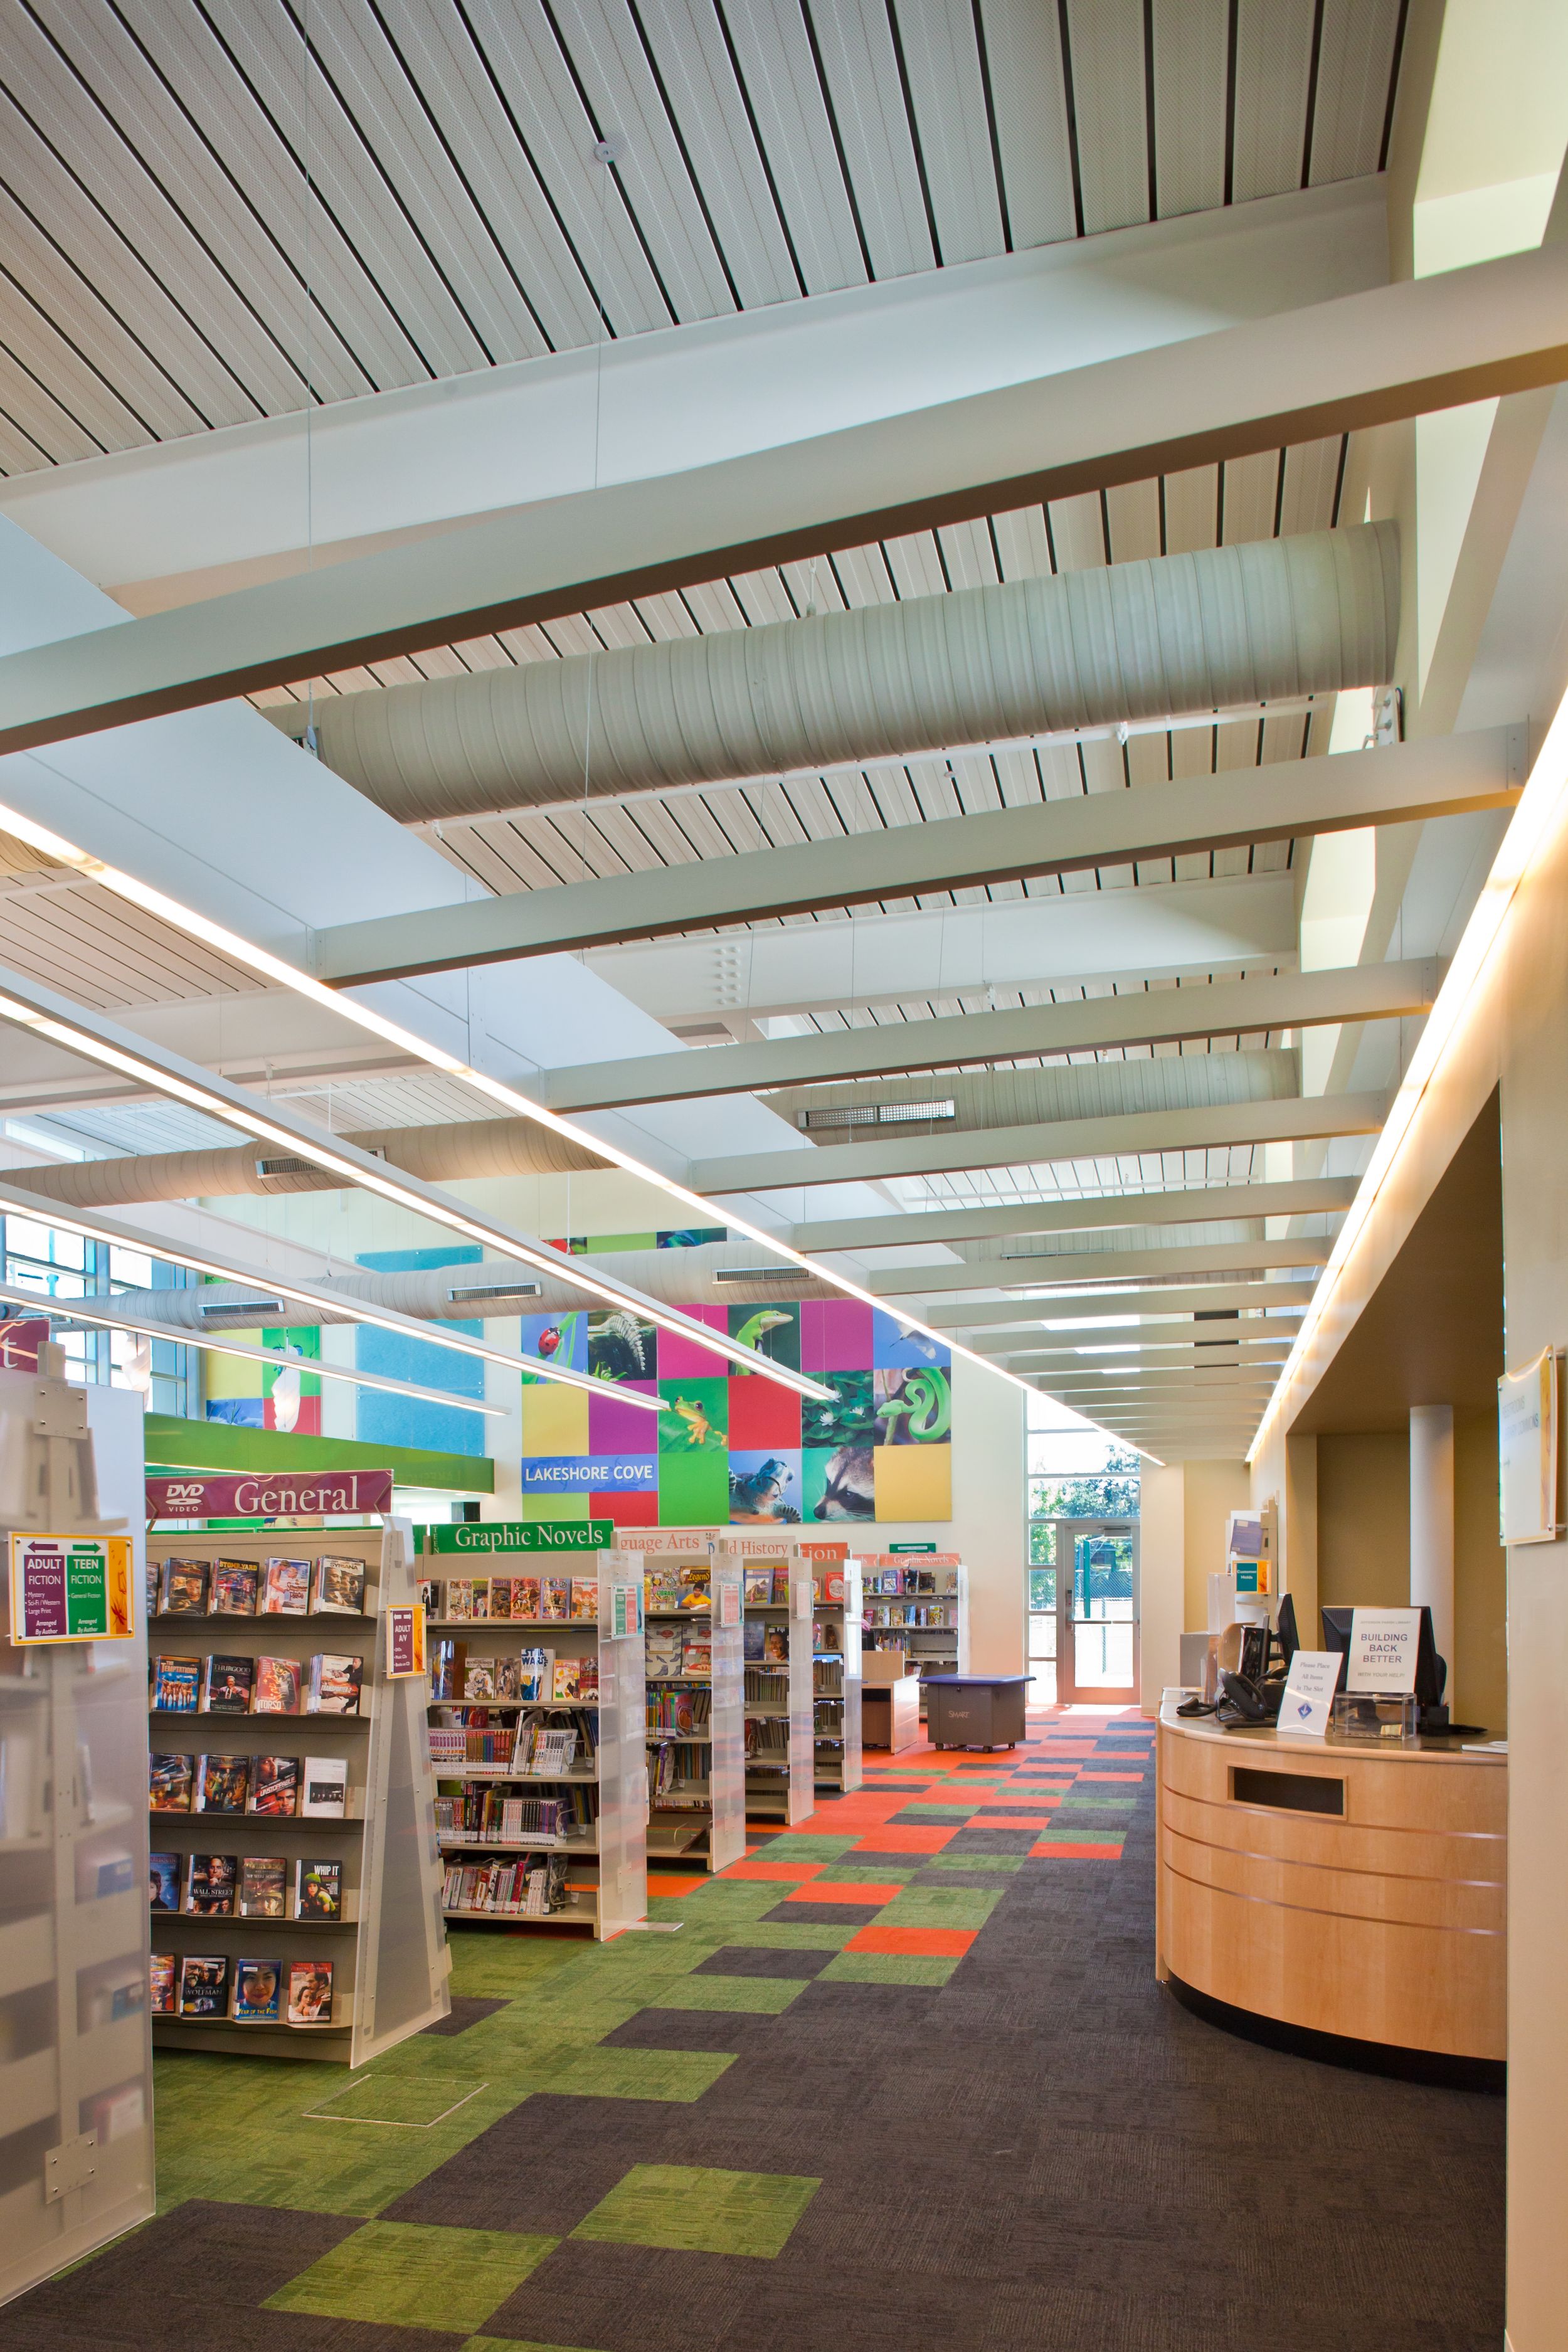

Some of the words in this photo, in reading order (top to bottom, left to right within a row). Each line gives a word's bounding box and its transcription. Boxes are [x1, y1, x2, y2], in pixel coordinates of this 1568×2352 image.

[1, 1337, 18, 1369] t
[526, 1466, 609, 1481] LAKESHORE
[613, 1465, 653, 1479] COVE
[166, 1484, 204, 1498] DVD
[235, 1475, 360, 1514] General
[455, 1524, 531, 1553] Graphic
[536, 1523, 603, 1545] Novels
[620, 1537, 662, 1554] guage
[667, 1533, 700, 1549] Arts
[741, 1541, 788, 1558] History
[800, 1545, 837, 1560] tion
[28, 1559, 62, 1569] ADULT
[73, 1559, 99, 1569] TEEN
[894, 1555, 921, 1566] Graphic
[924, 1555, 949, 1564] Novels
[28, 1576, 61, 1585] FICTION
[71, 1575, 102, 1584] FICTION
[687, 1572, 711, 1582] Legend
[1360, 1633, 1407, 1641] BUILDING
[1369, 1644, 1397, 1652] BACK
[161, 1663, 198, 1674] TEMPTATIONS
[214, 1663, 251, 1673] THURGOOD
[260, 1700, 281, 1710] TORSO
[948, 1710, 970, 1719] SMART
[314, 1865, 331, 1875] WHIP
[332, 1866, 339, 1876] IT
